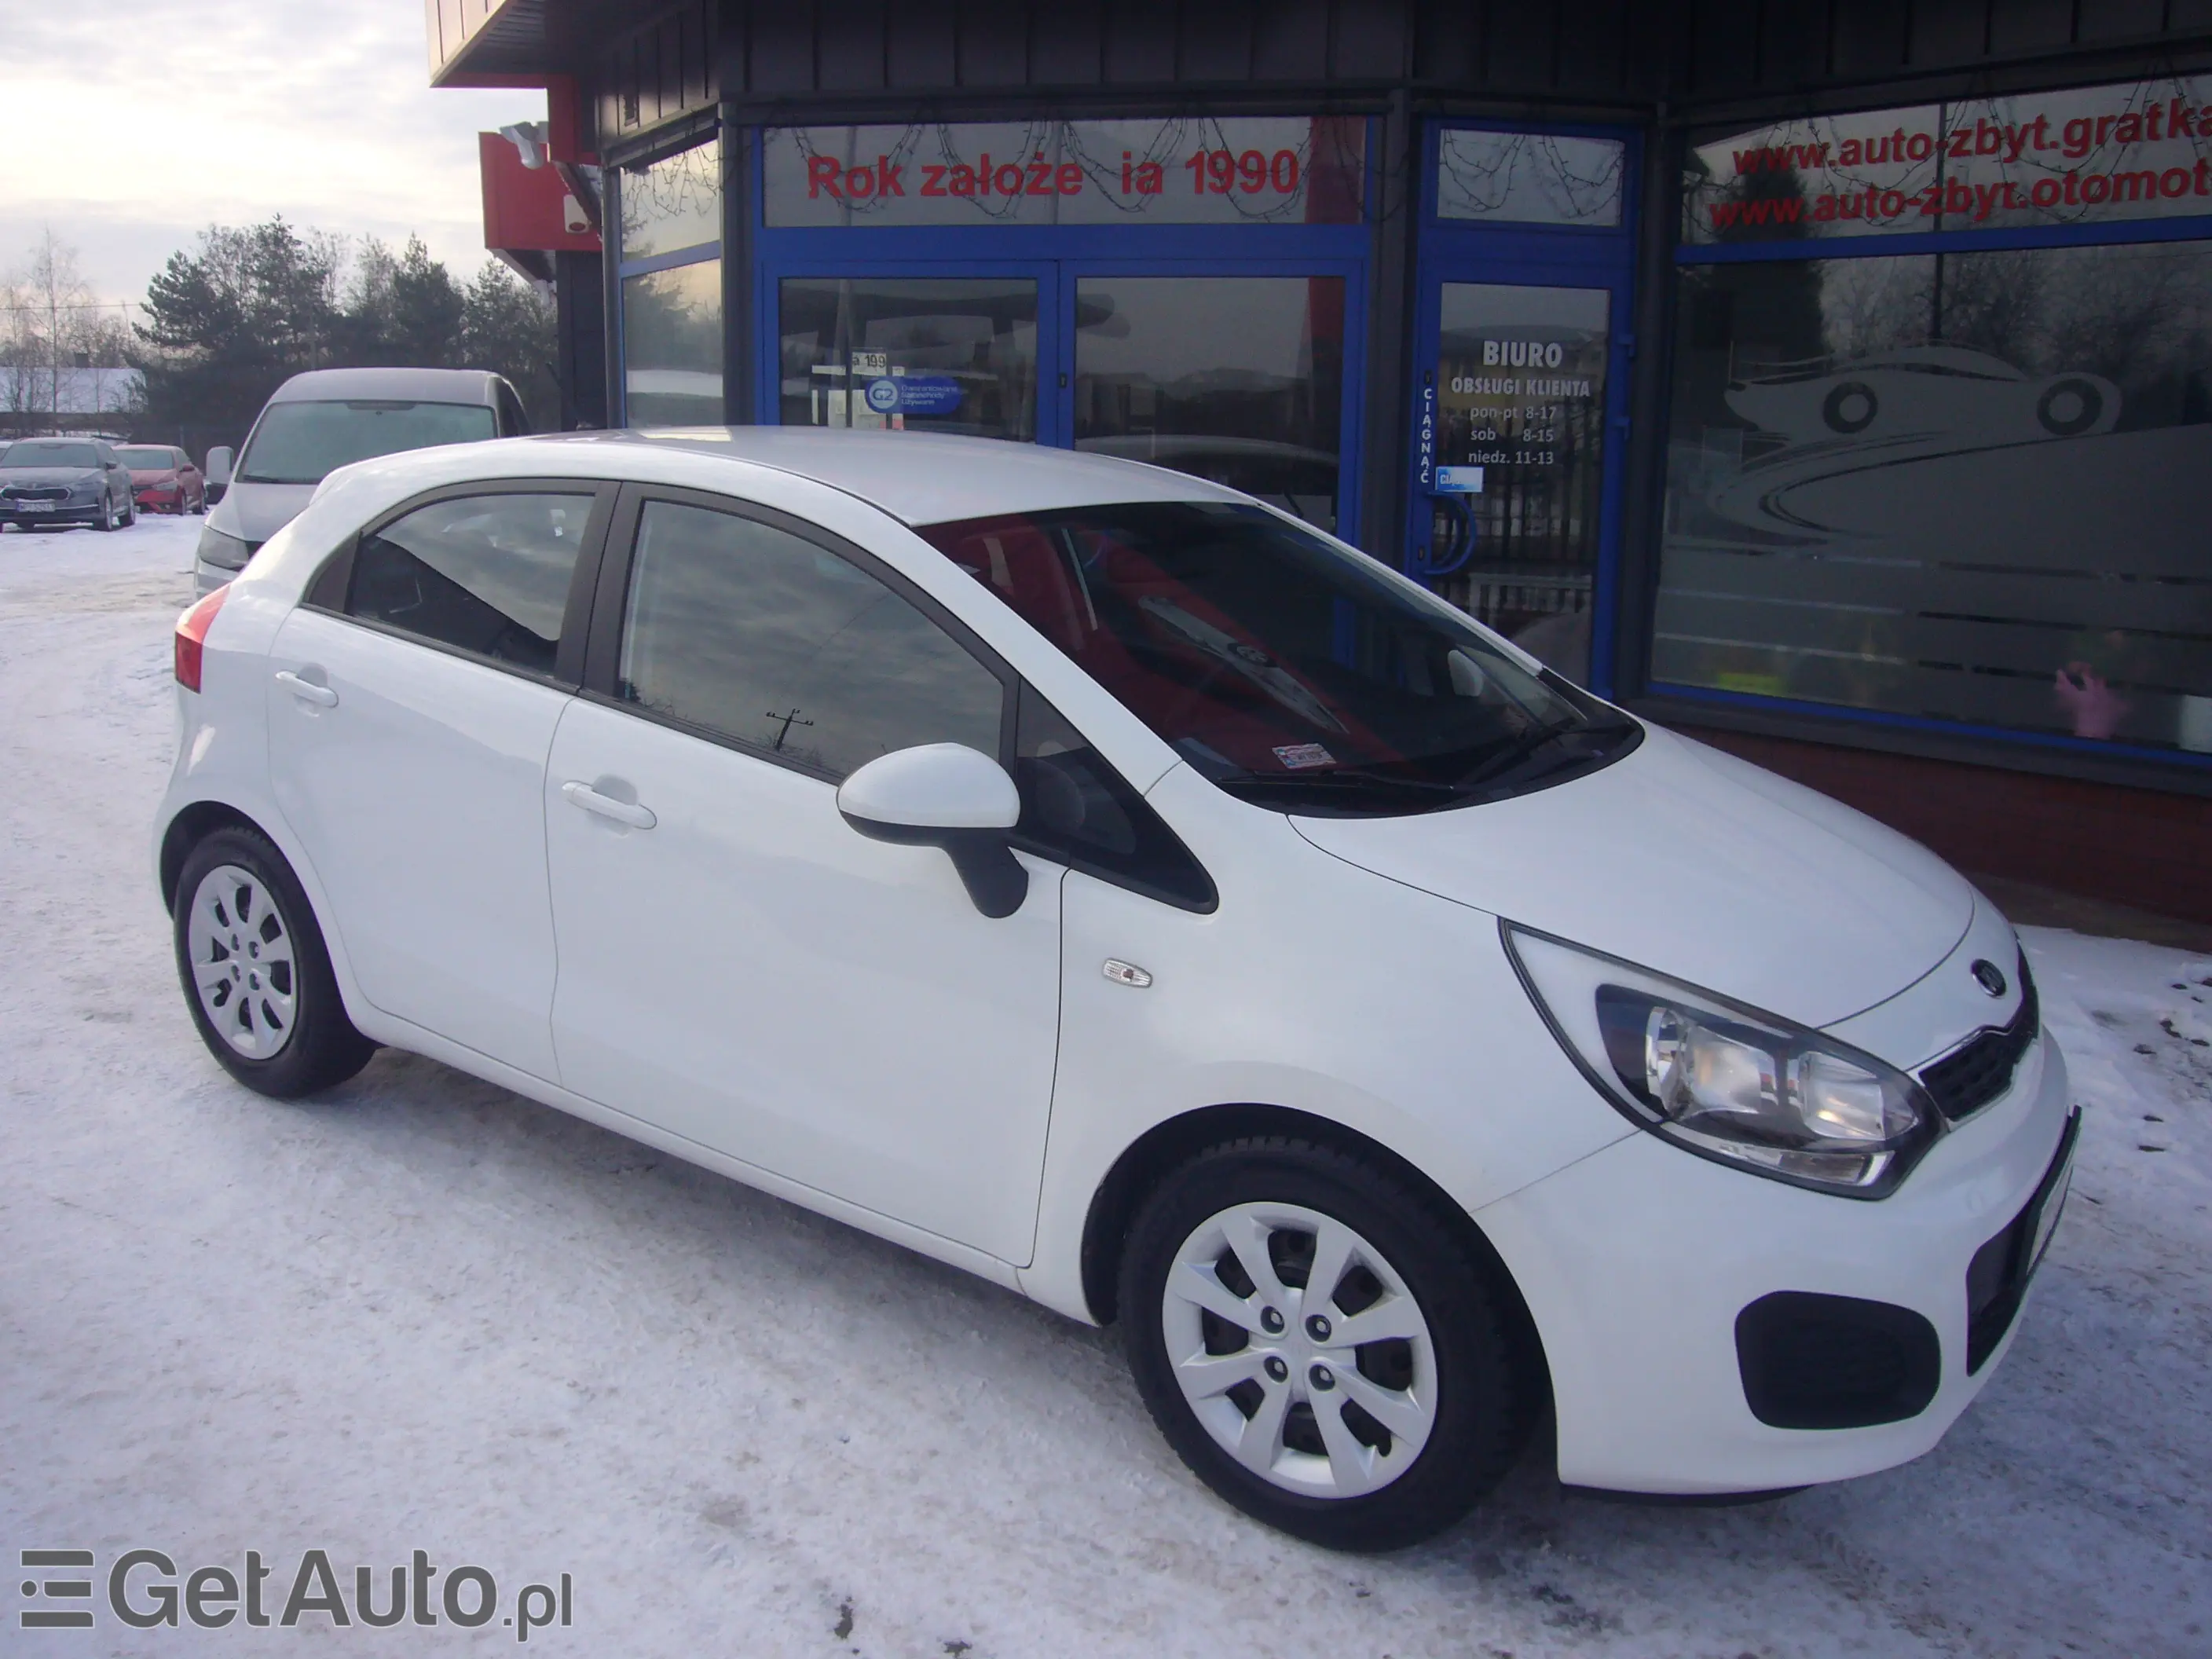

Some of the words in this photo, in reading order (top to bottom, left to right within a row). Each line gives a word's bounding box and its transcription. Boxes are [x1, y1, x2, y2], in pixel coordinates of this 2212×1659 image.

[808, 156, 905, 199] Rok
[1185, 149, 1299, 195] 1990
[1483, 340, 1562, 368] BIURO
[1451, 377, 1519, 395] OBSŁUGI
[1526, 379, 1591, 397] KLIENTA
[1470, 406, 1518, 421] pon-pt
[1525, 406, 1557, 420] 8-17
[1420, 388, 1433, 484] CIĄGNĄĆ
[1470, 428, 1496, 441] sob
[1522, 429, 1554, 442] 8-15
[1468, 450, 1510, 465] niedz.
[1515, 451, 1554, 465] 11-13
